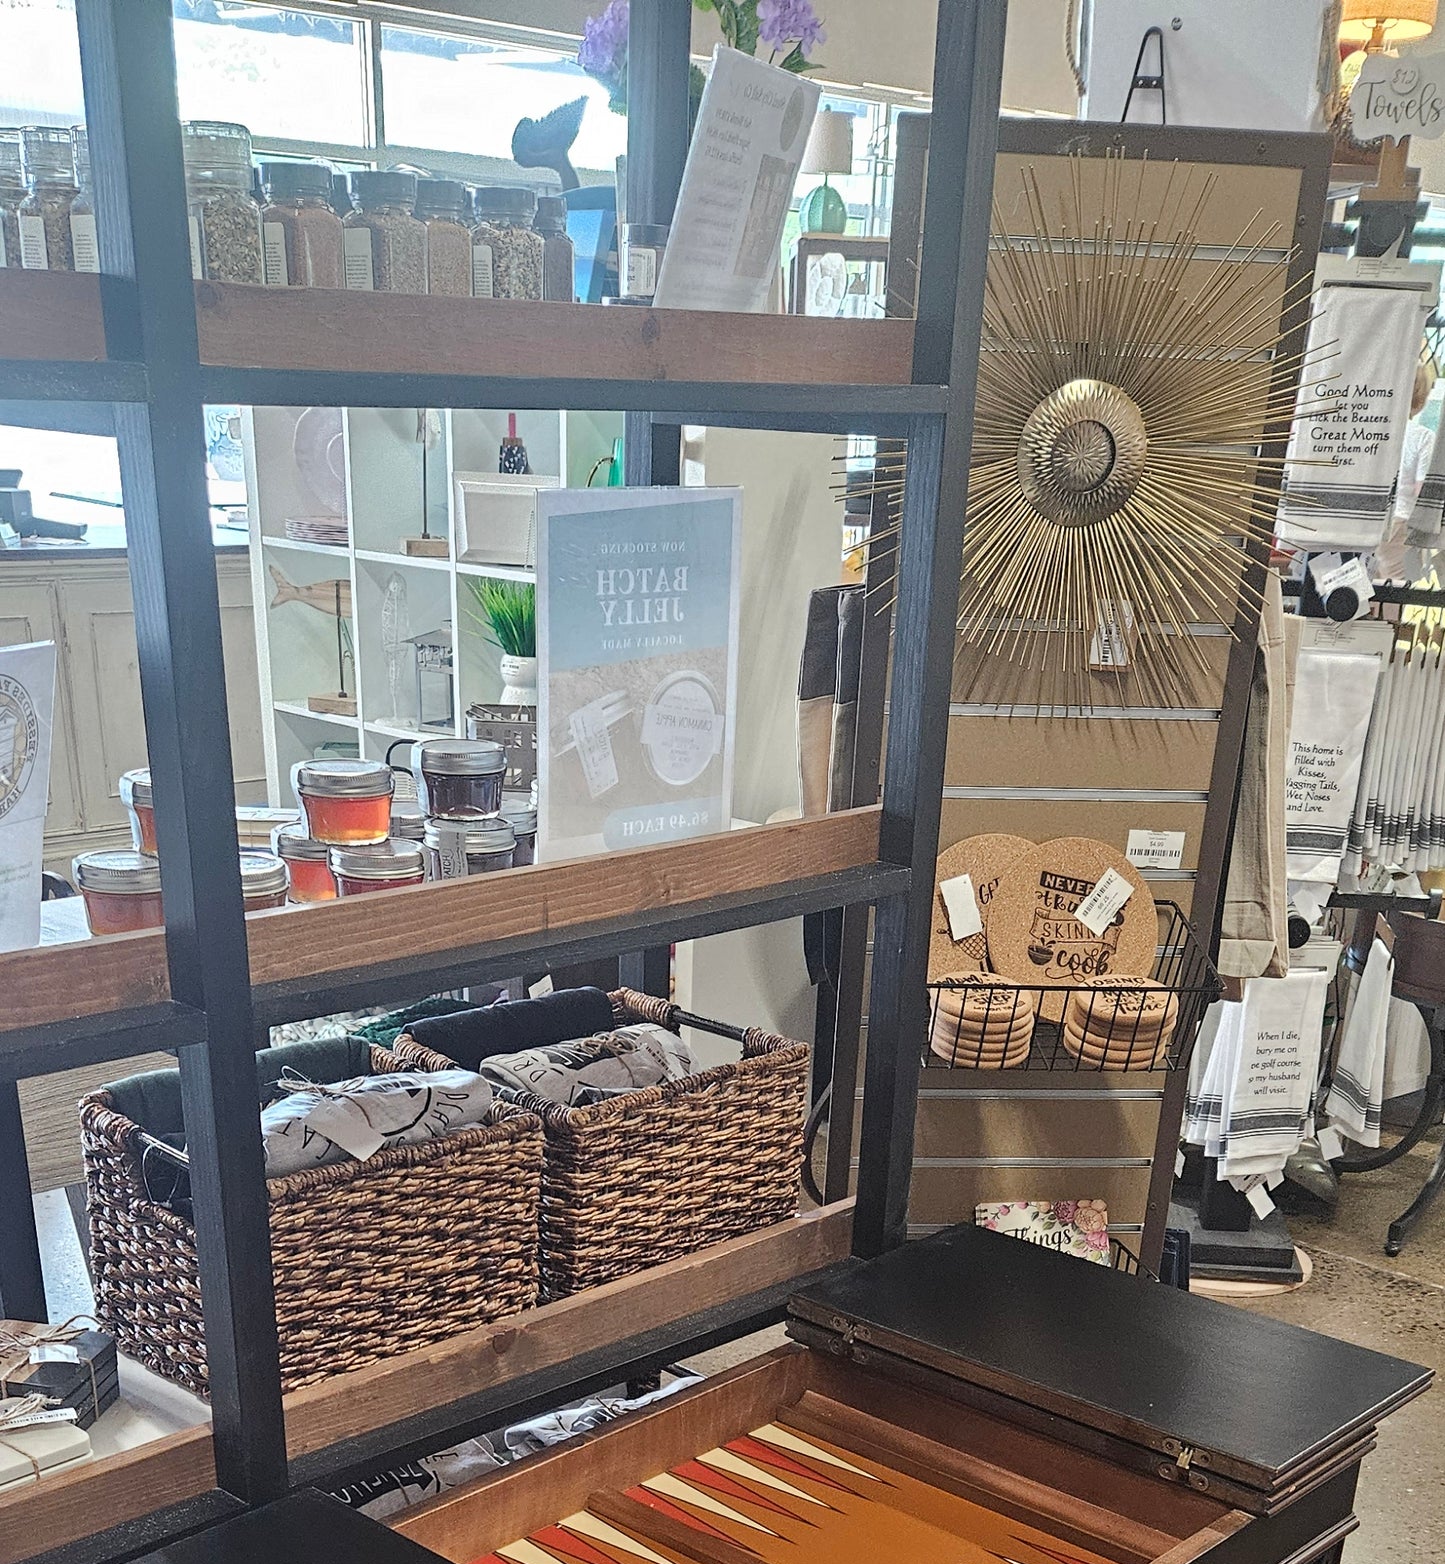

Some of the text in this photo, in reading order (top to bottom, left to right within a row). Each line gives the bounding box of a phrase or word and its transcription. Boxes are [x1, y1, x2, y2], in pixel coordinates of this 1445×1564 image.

[1358, 80, 1445, 126] Towels
[1315, 383, 1394, 398] Good Moms
[1351, 403, 1369, 412] you
[1332, 412, 1348, 422] the
[1351, 412, 1391, 423] Beaters.
[1311, 426, 1390, 441] Great Moms
[1313, 442, 1379, 455] turn them off
[1292, 742, 1344, 755] This home is
[1295, 755, 1336, 767] filled with
[1298, 766, 1327, 779] Kisses,
[1319, 780, 1341, 792] Tails,
[1304, 791, 1331, 801] Noses
[1286, 803, 1303, 811] and
[1257, 1031, 1279, 1040] When
[1286, 1030, 1301, 1041] die,
[1256, 1046, 1273, 1056] bury
[1261, 1058, 1277, 1070] golf
[1255, 1075, 1267, 1083] my
[1268, 1072, 1301, 1080] husband
[1253, 1086, 1269, 1095] will
